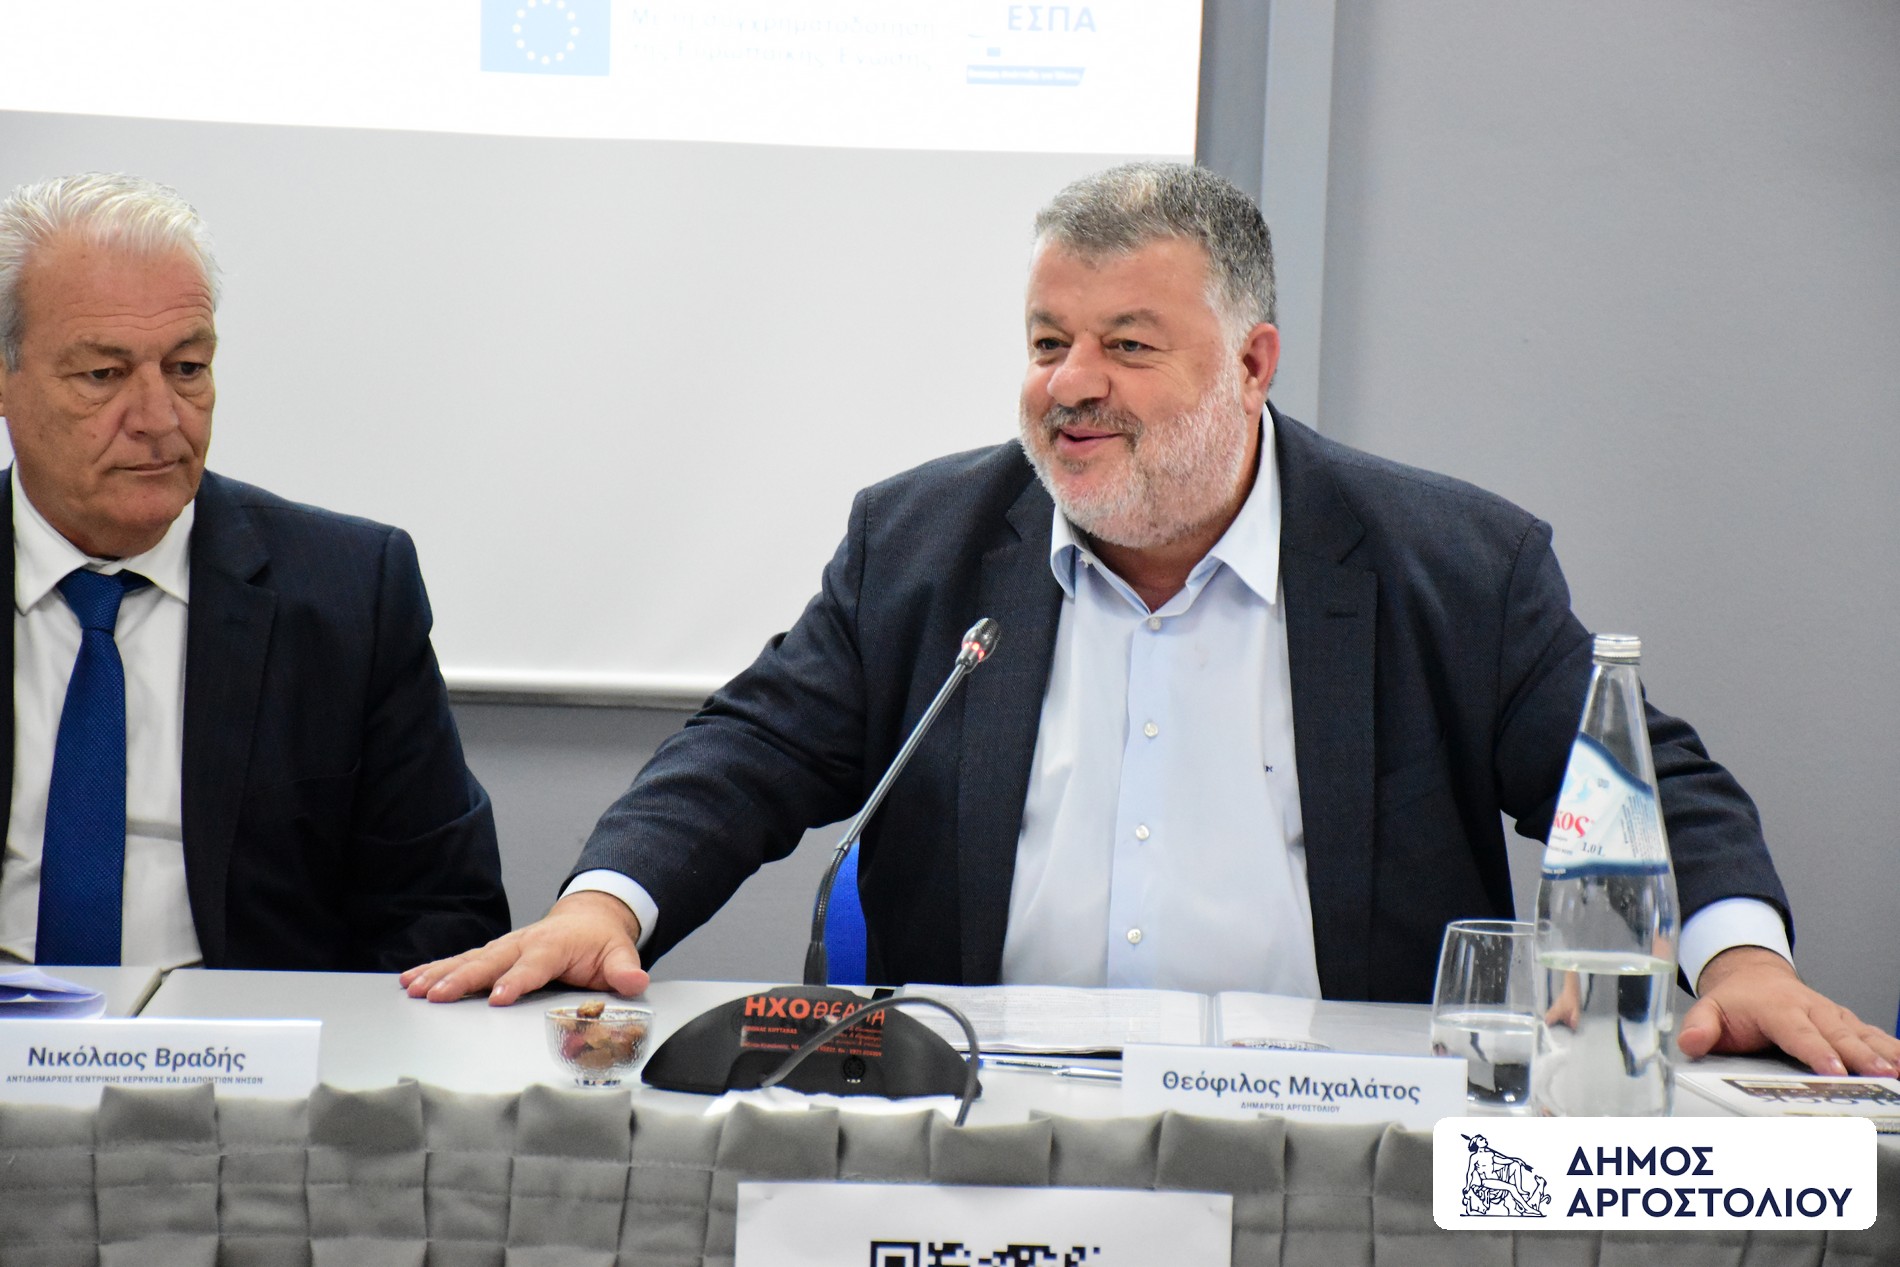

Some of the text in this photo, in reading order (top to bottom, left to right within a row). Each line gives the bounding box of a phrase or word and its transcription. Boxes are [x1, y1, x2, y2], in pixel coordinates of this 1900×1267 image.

[1008, 4, 1097, 32] ΕΣΠΑ
[28, 1045, 246, 1072] Νικόλαος Βραδής
[6, 1074, 73, 1084] ΑΝΤΙΔΗΜΑΡΧΟΣ
[75, 1074, 121, 1084] ΚΕΝΤΡΙΚΗΣ
[122, 1075, 164, 1084] ΚΕΡΚΥΡΑΣ
[166, 1075, 181, 1084] ΚΑΙ
[235, 1076, 263, 1085] ΝΗΣΩΝ
[1162, 1070, 1421, 1104] Θεόφιλος Μιχαλάτος
[1240, 1101, 1340, 1113] ΔΗΜΑΡΧΟΣ ΑΡΓΟΣΤΟΛΙΟΥ
